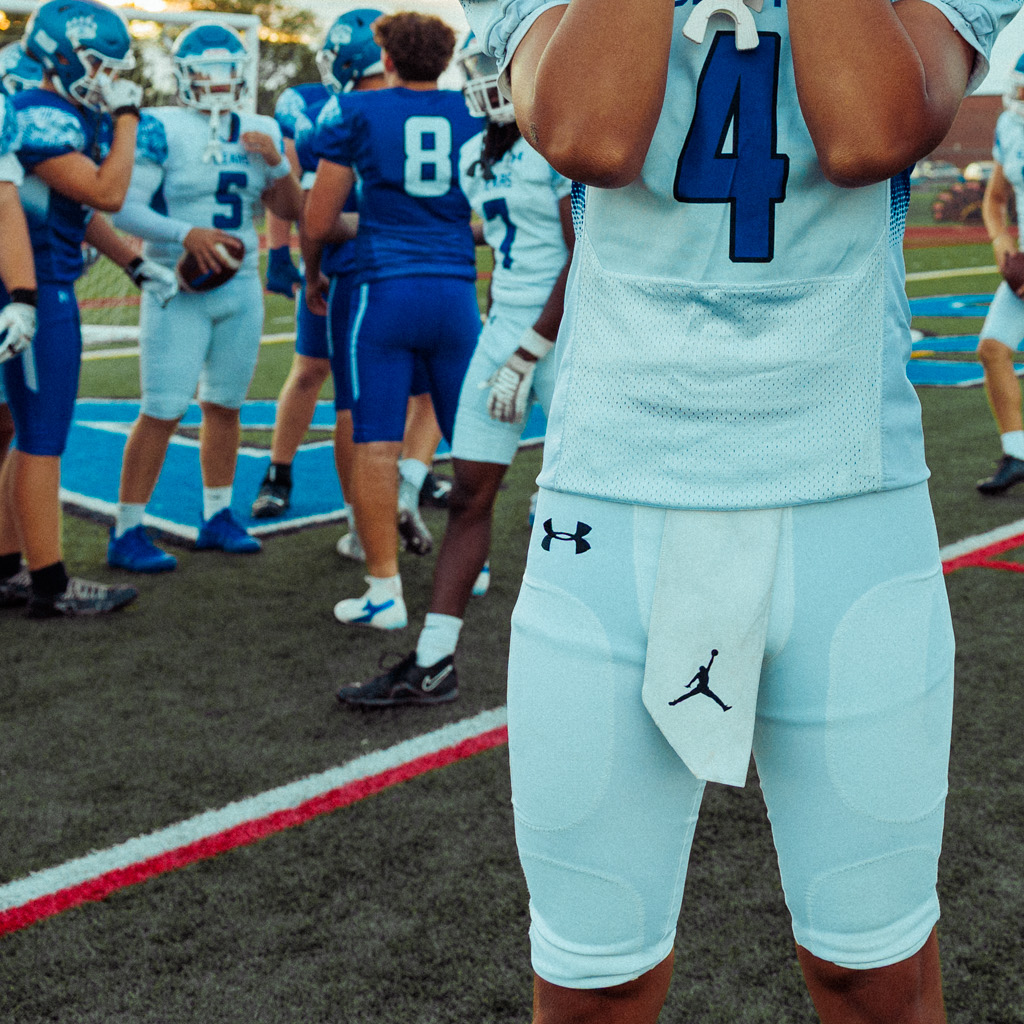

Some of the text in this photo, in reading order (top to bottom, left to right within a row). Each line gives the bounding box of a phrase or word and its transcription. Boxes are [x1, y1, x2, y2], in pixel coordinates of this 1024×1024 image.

[404, 115, 452, 198] 8
[673, 30, 790, 263] 4
[213, 171, 248, 230] 5
[483, 198, 517, 270] 7
